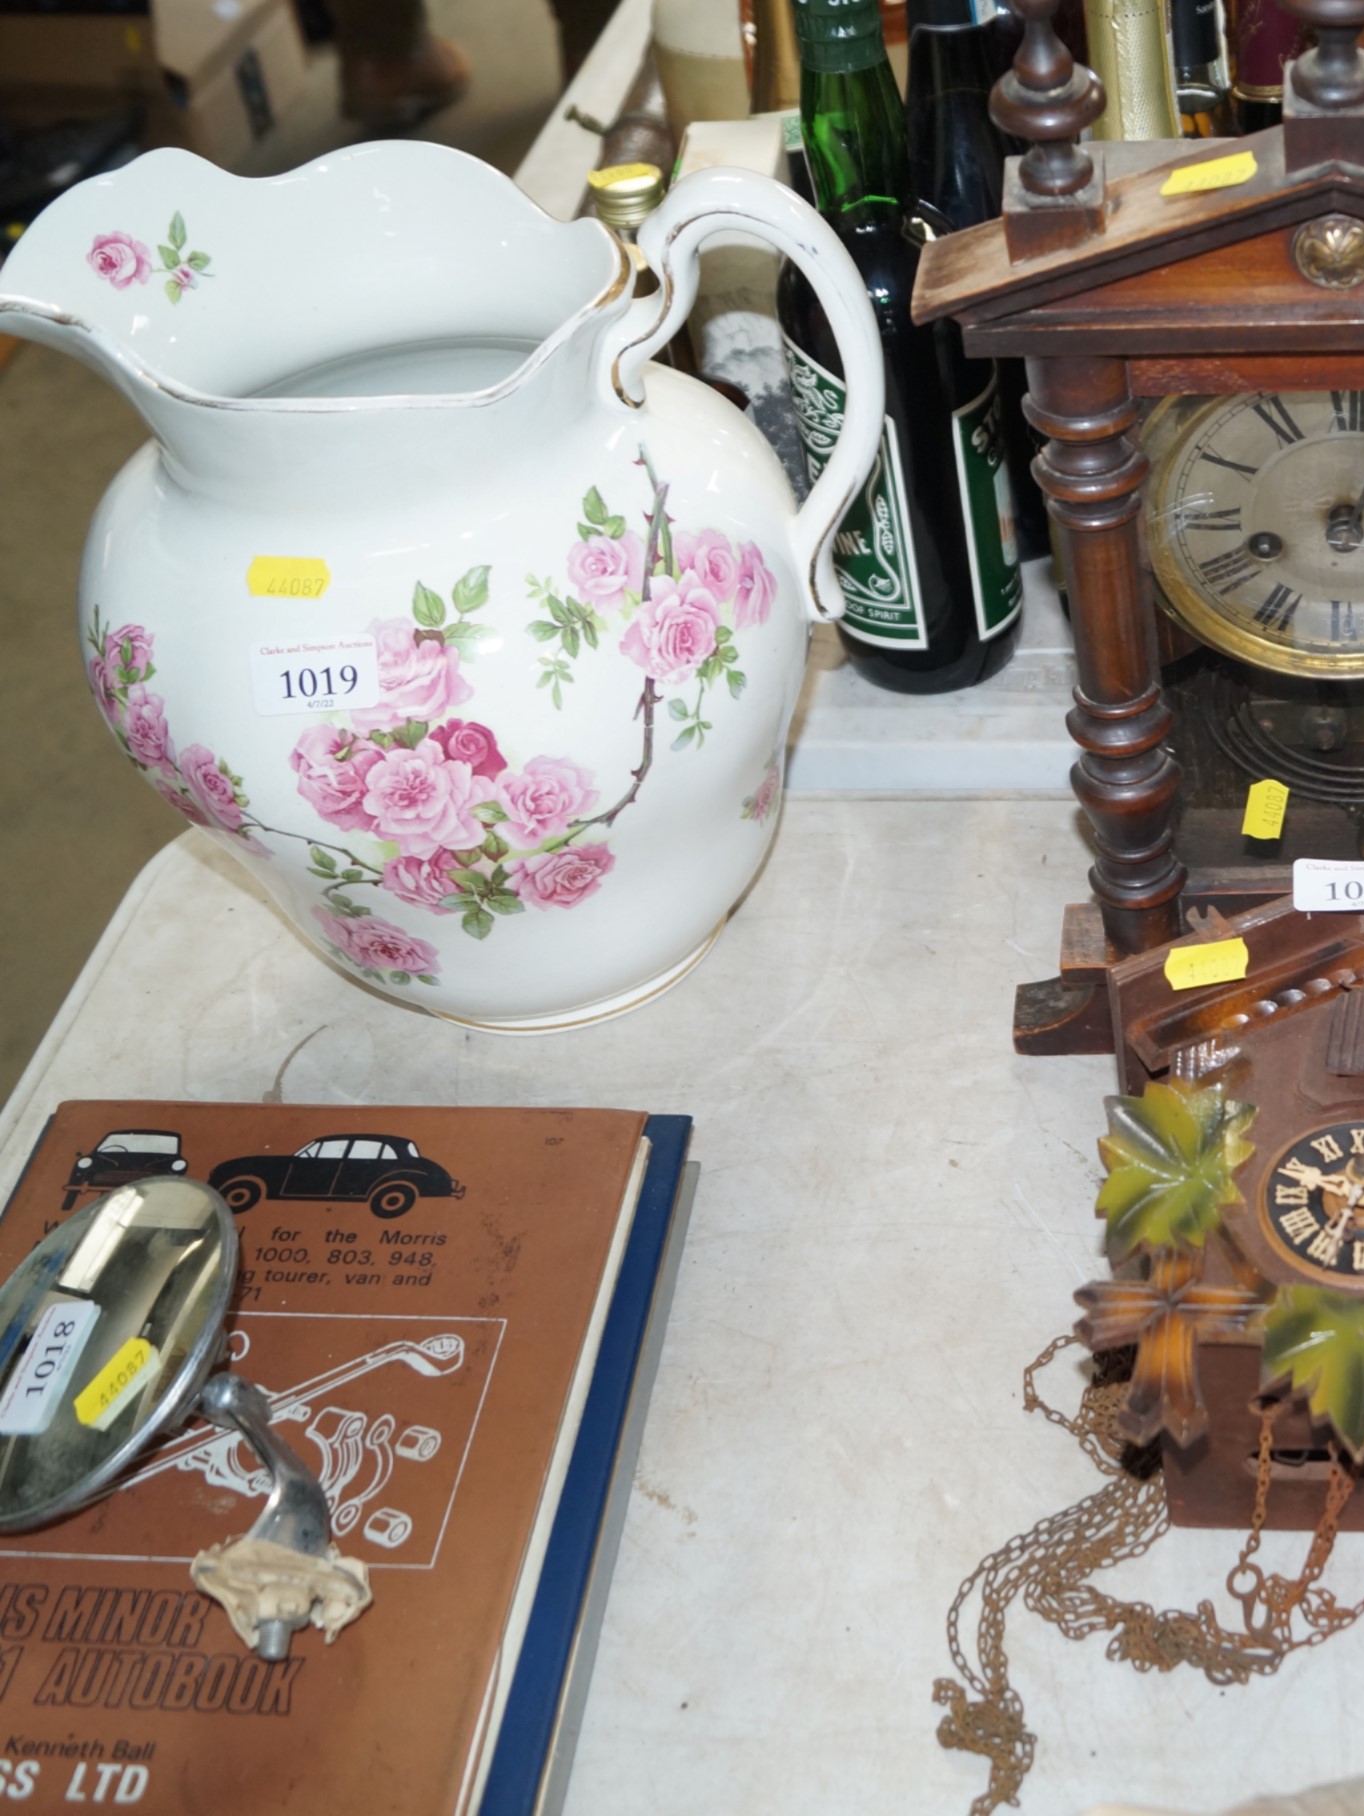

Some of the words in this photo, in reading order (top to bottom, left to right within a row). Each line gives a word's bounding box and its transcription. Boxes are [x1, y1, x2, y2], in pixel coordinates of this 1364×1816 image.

[833, 530, 872, 556] INE
[267, 578, 325, 597] 44087
[867, 608, 902, 621] SPIRIT
[260, 647, 285, 656] Clarke
[287, 645, 301, 654] and
[302, 643, 336, 653] Simpson
[338, 640, 374, 649] Auctions
[280, 664, 358, 700] 1019
[1262, 785, 1285, 827] 44087
[271, 1227, 302, 1243] for
[324, 1229, 358, 1244] the
[380, 1230, 447, 1246] Morris
[264, 1269, 331, 1286] tourer,
[345, 1272, 381, 1286] van
[392, 1271, 432, 1287] and
[26, 1320, 76, 1398] 1018
[100, 1350, 146, 1407] 44087
[42, 1586, 212, 1648] MINOR
[33, 1646, 306, 1717] AUTOBOOK
[5, 1736, 106, 1759] Kenneth
[111, 1740, 156, 1761] Ball
[65, 1762, 150, 1805] LTD
